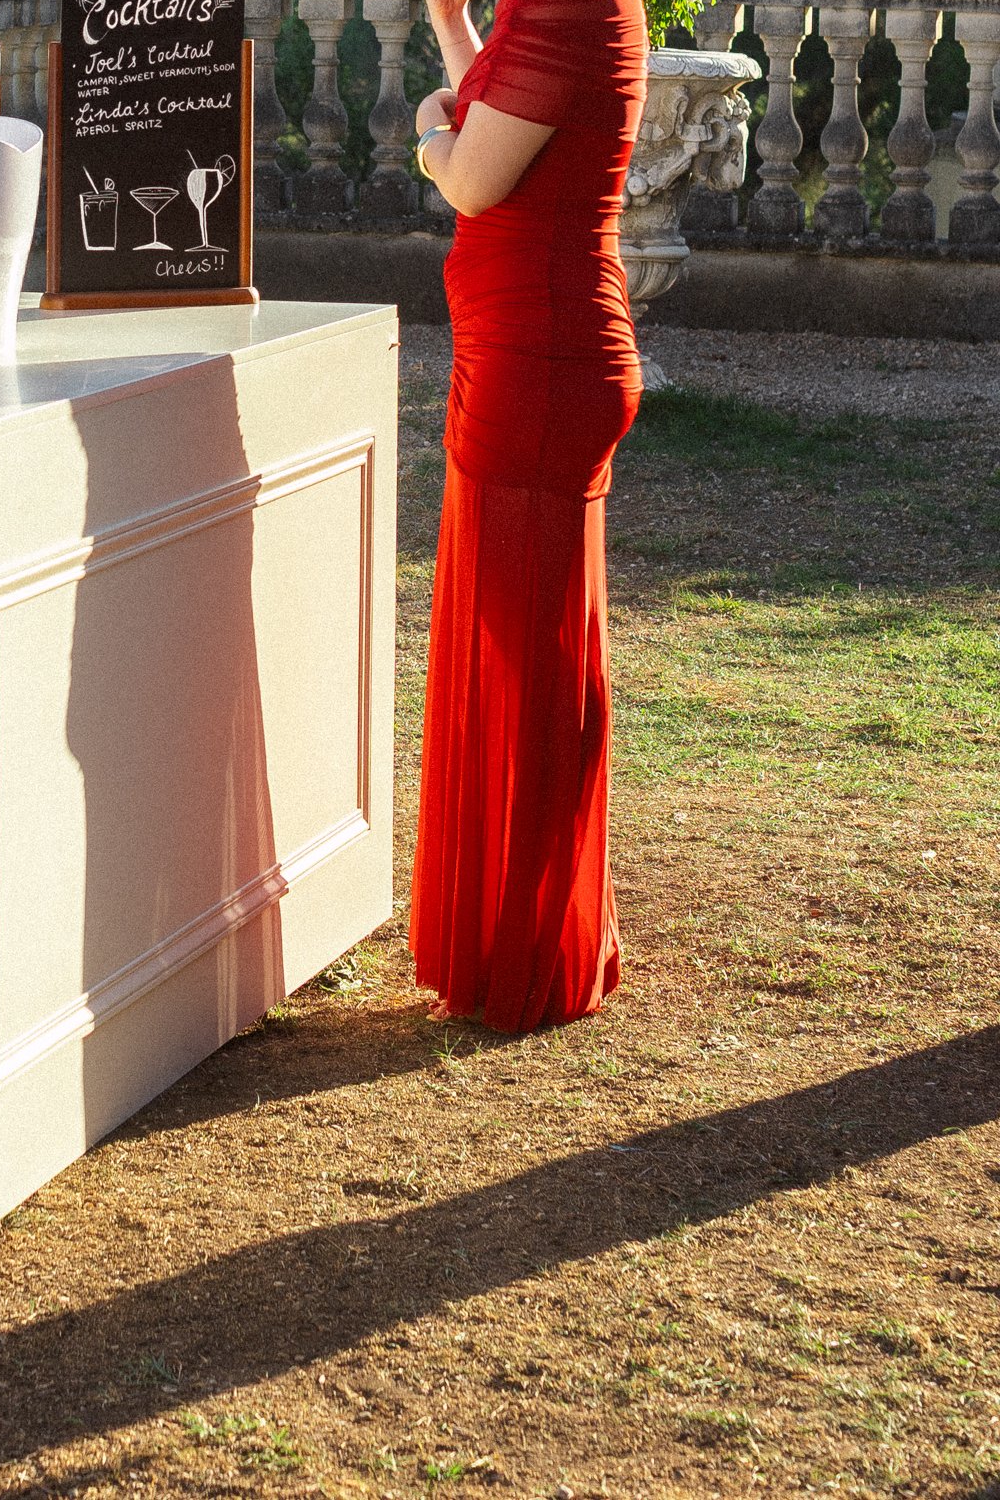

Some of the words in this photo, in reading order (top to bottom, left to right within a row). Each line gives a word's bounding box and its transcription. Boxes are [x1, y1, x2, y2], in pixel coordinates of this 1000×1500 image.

[85, 46, 136, 75] Joel's
[147, 40, 214, 65] Cocktail
[213, 62, 236, 73] SODA
[77, 86, 110, 98] WATER
[75, 100, 150, 126] Linda's
[157, 93, 232, 114] Cocktail
[75, 125, 119, 137] APEROL
[124, 119, 163, 132] SPRITZ
[155, 254, 225, 277] Cheers!!
